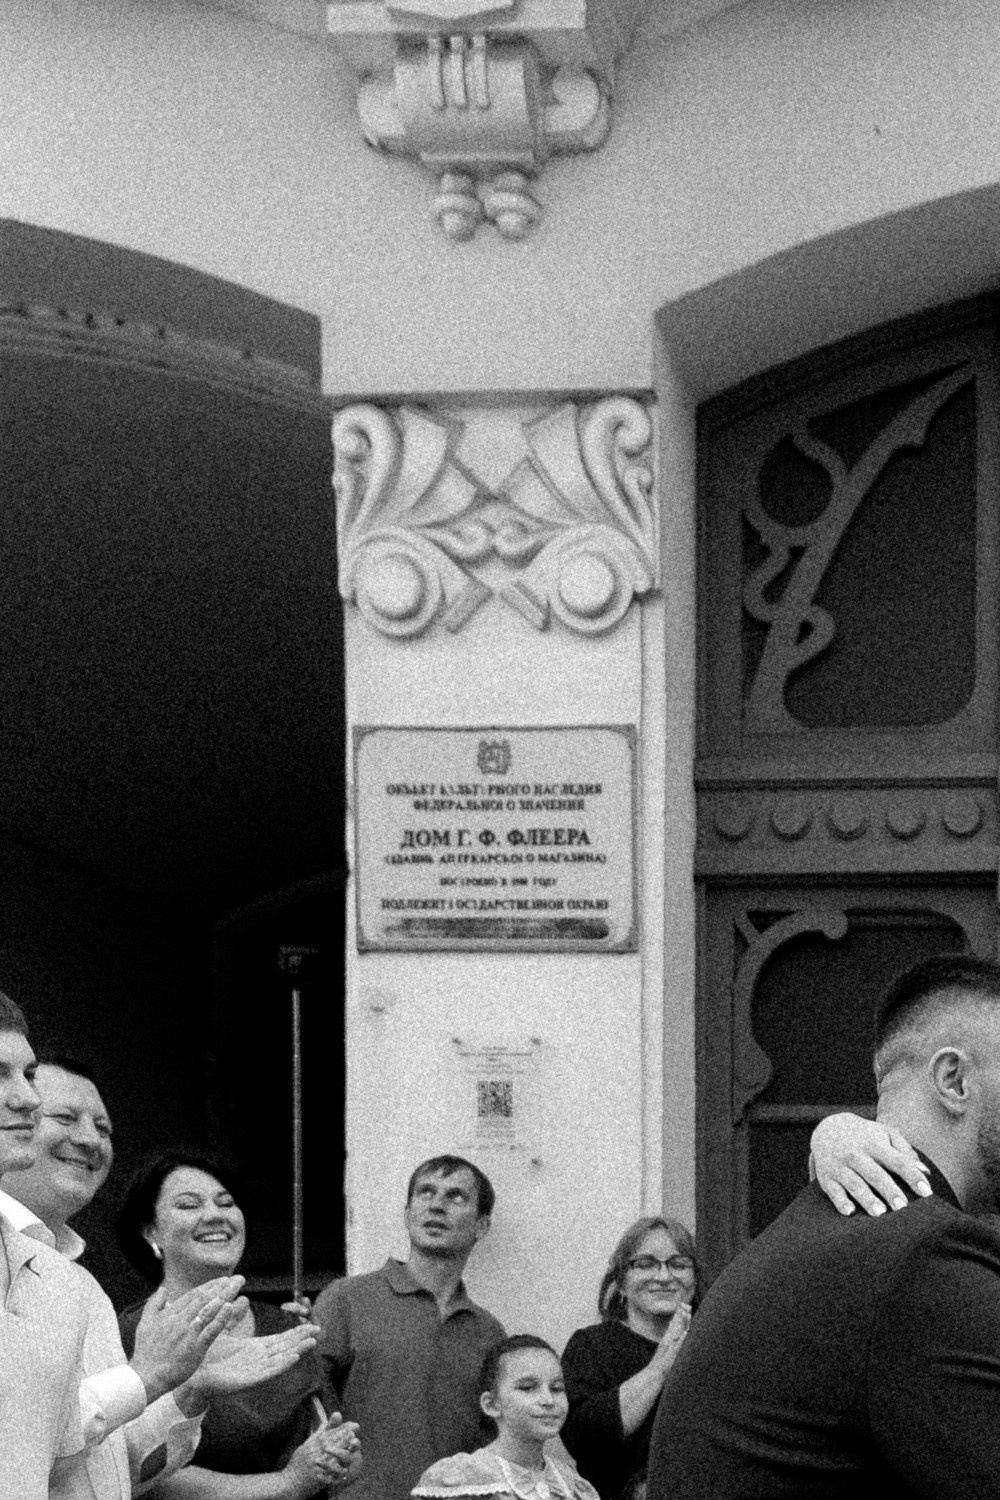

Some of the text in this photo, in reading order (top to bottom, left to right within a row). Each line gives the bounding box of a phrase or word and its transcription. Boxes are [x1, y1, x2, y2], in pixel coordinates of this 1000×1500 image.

[400, 828, 591, 850] ДОМ Г. Ф. ФЛЕЕРА
